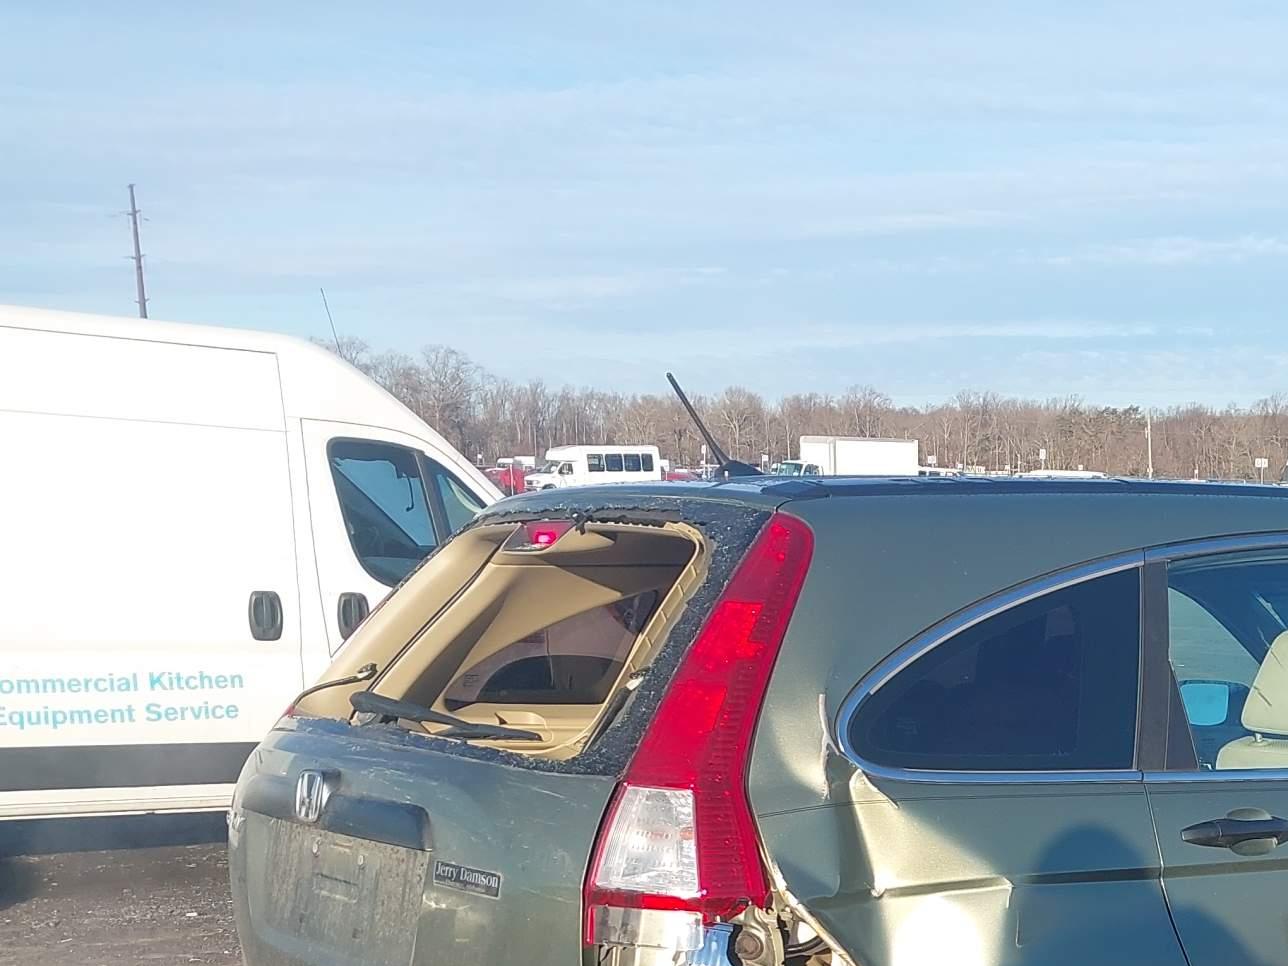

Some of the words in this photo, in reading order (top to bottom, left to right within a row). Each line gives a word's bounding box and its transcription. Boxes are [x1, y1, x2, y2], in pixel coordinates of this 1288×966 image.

[0, 673, 138, 694] ommercial
[149, 671, 244, 691] Kitchen
[145, 702, 239, 722] Service
[436, 862, 458, 880] Jerry
[460, 867, 499, 888] Damson
